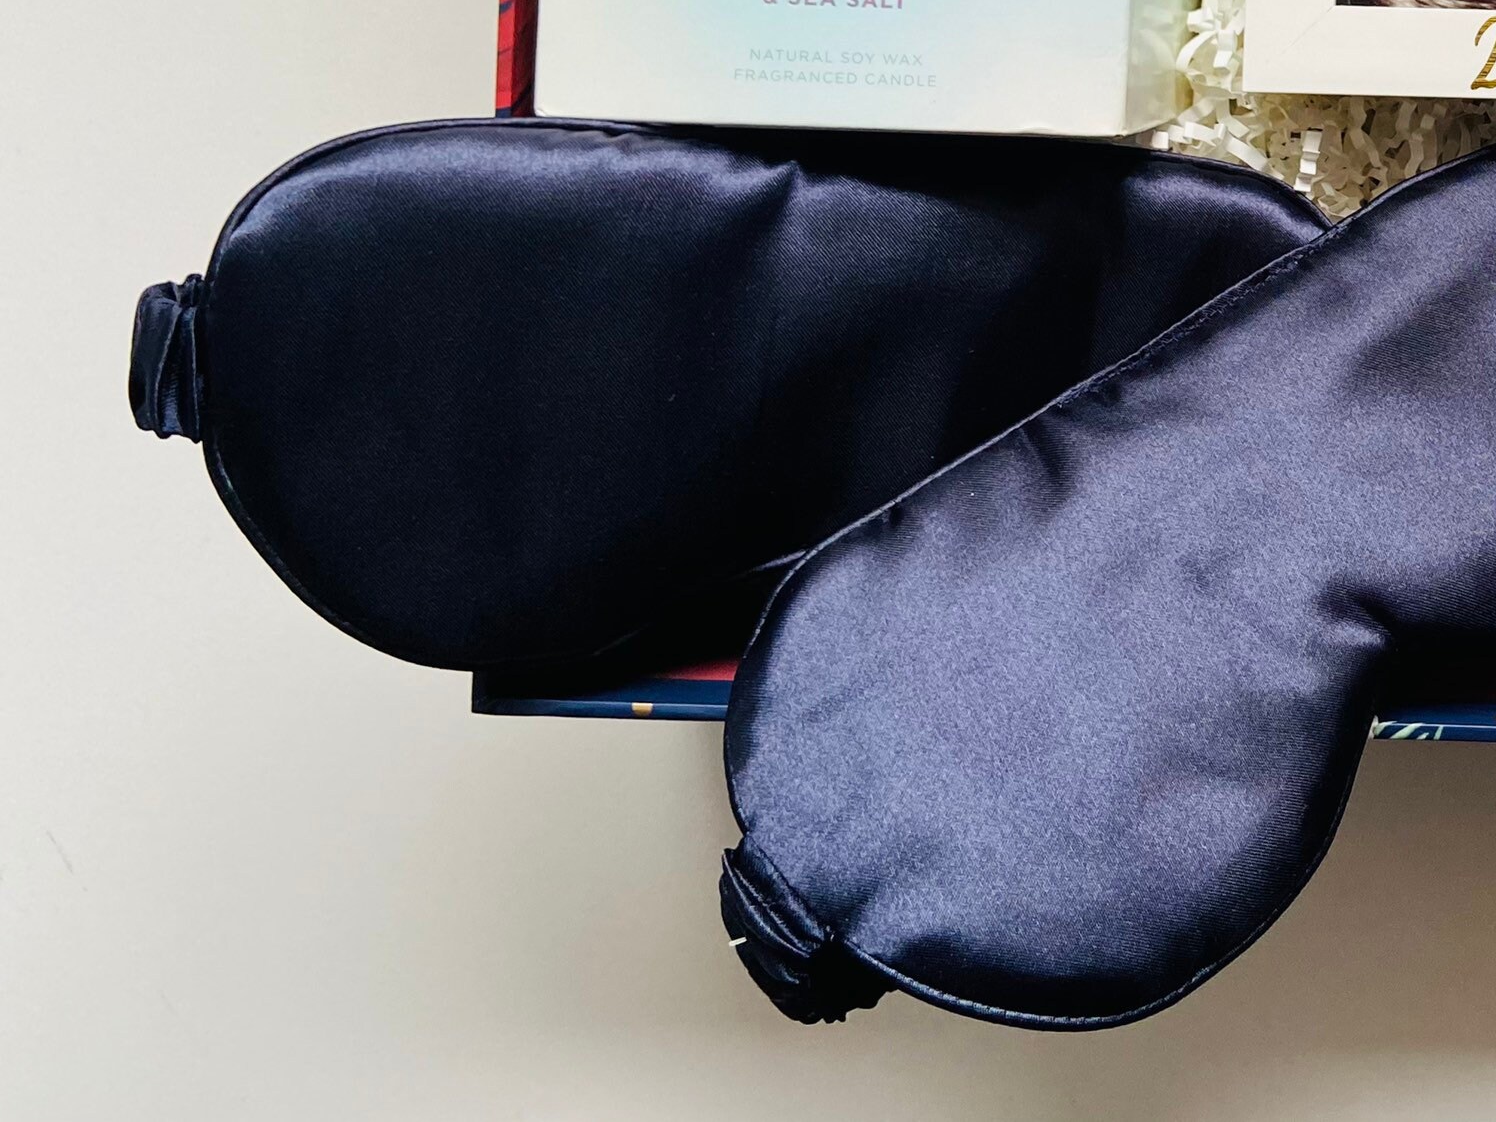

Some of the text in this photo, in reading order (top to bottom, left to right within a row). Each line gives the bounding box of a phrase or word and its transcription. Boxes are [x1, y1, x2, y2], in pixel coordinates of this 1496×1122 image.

[749, 48, 923, 66] NATURAL SOY WAX
[733, 68, 937, 88] FRAGRANCED CANDLE
